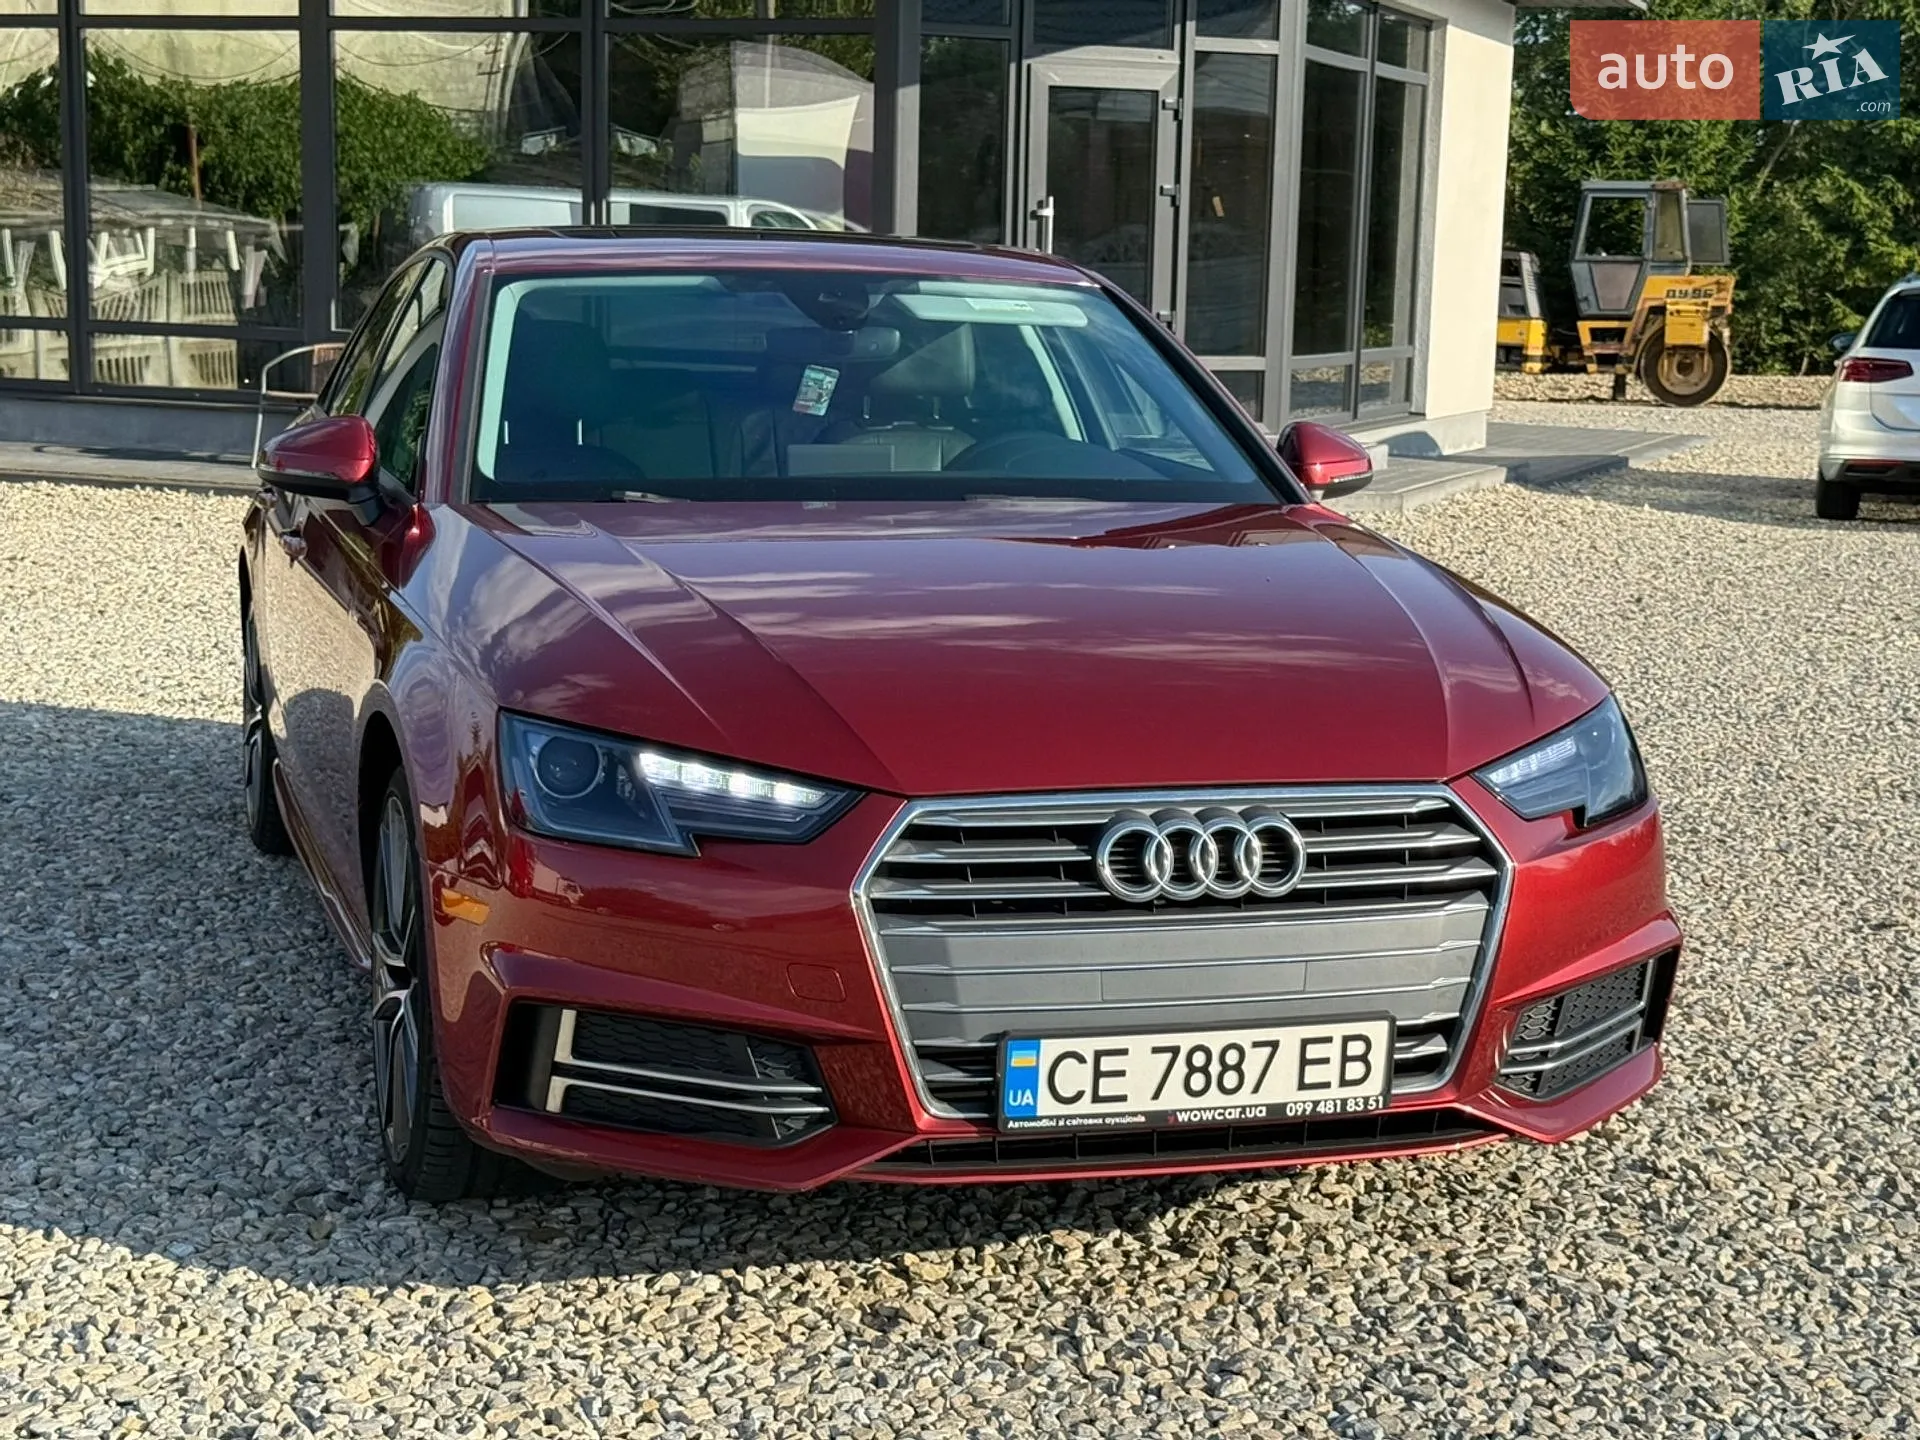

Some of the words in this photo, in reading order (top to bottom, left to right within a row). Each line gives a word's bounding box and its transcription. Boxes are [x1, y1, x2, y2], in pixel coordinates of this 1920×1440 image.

[1047, 1048, 1129, 1106] CE
[1150, 1039, 1280, 1101] 7887
[1297, 1034, 1373, 1092] EB
[1008, 1090, 1035, 1107] UA
[1286, 1102, 1314, 1117] 099
[1316, 1099, 1341, 1113] 481
[1346, 1098, 1364, 1112] 83
[1367, 1096, 1384, 1110] 51
[1176, 1106, 1267, 1123] wowcar.ua
